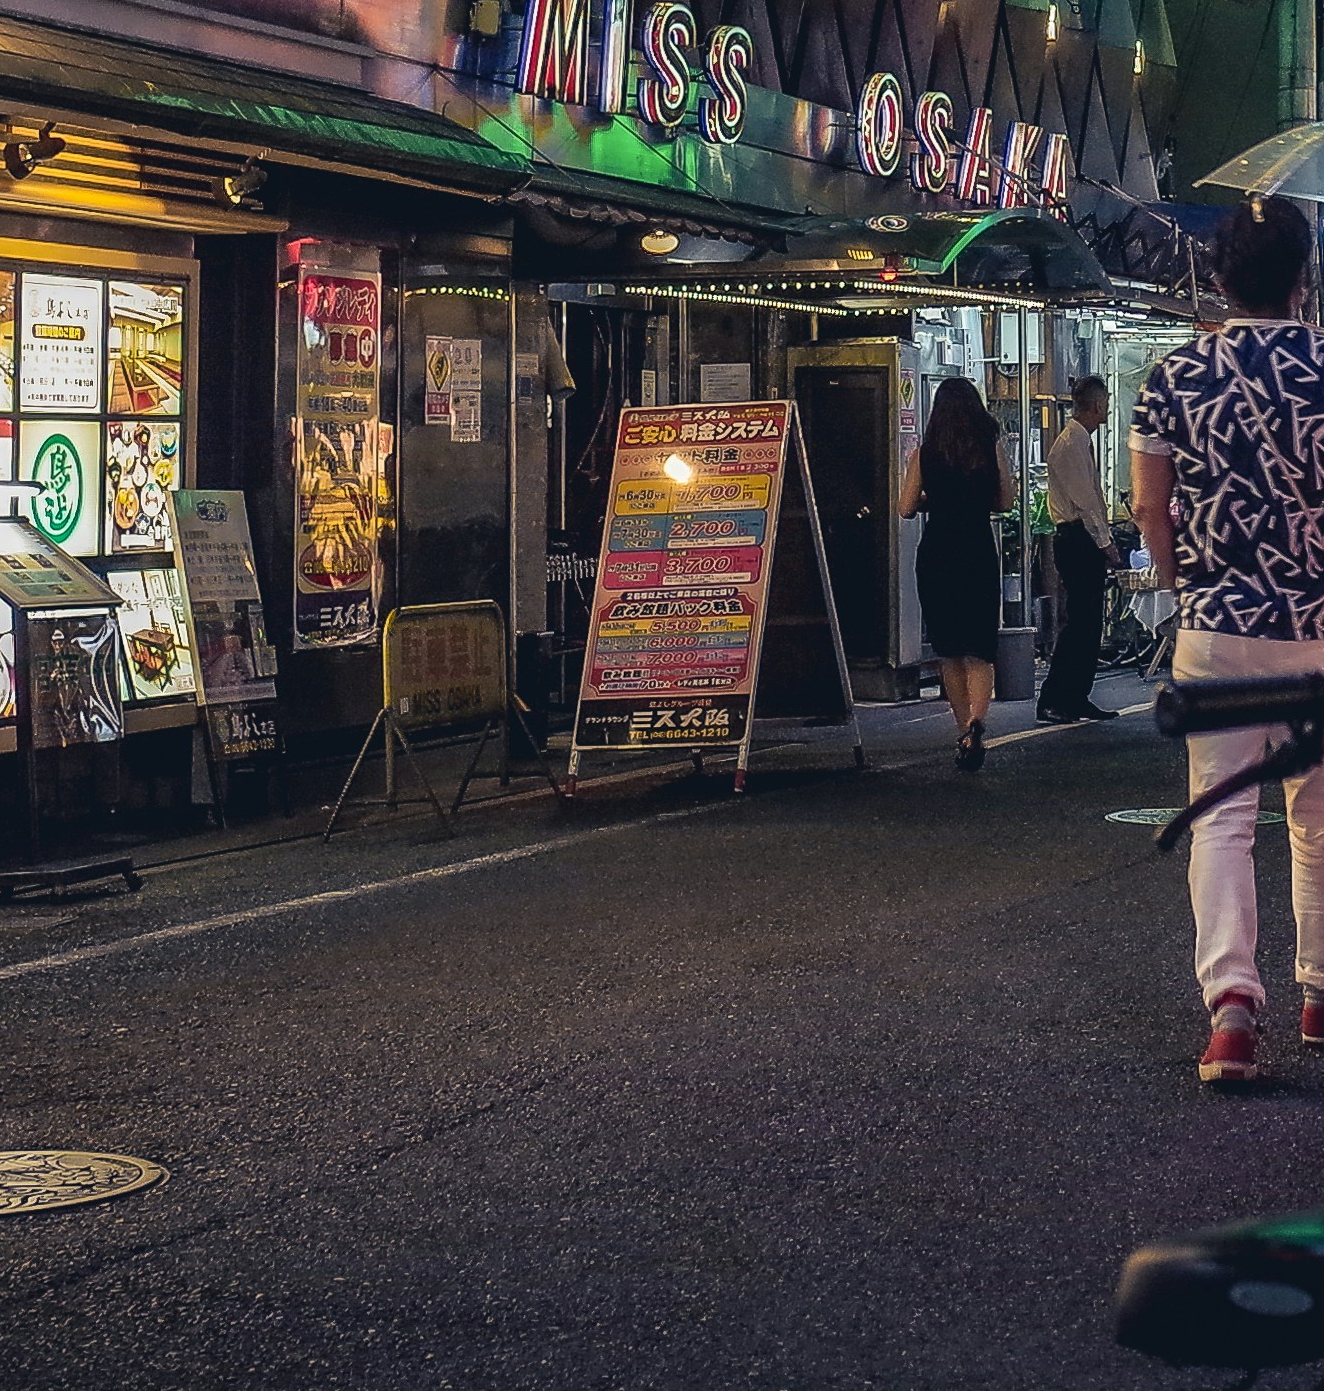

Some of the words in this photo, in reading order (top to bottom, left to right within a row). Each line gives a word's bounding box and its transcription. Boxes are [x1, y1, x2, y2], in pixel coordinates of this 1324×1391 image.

[857, 72, 1072, 221] OSAKA
[625, 425, 676, 444] ご安心
[679, 419, 780, 443] 料金システム
[610, 601, 742, 619] 飲み放題パック料金
[629, 731, 649, 740] TEL
